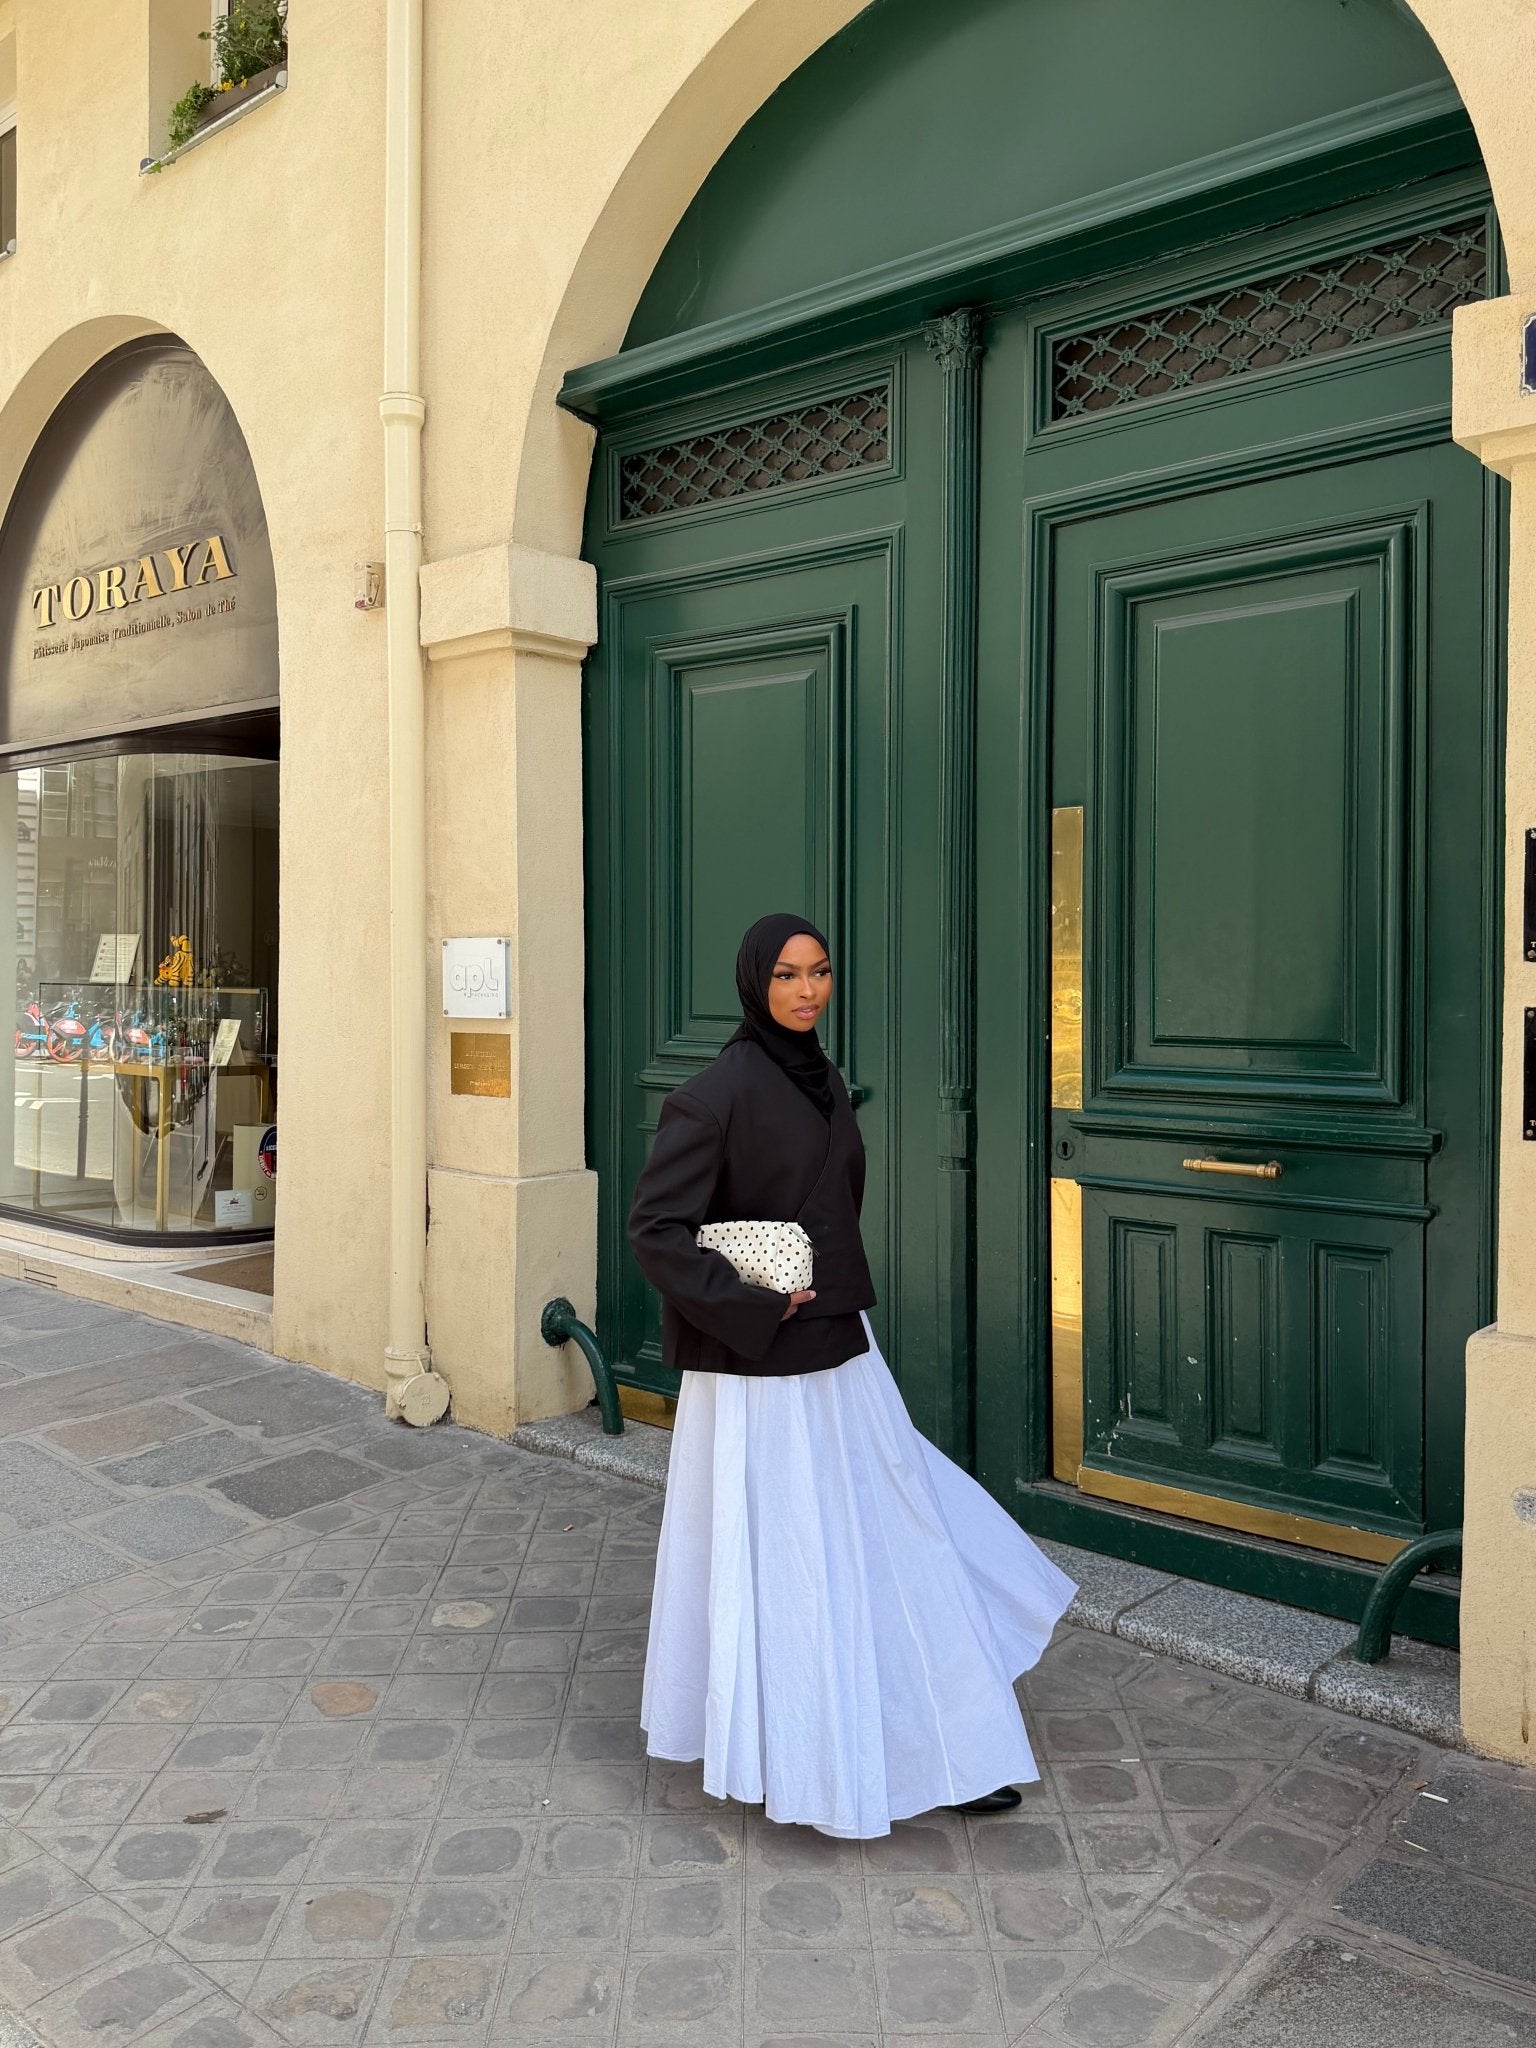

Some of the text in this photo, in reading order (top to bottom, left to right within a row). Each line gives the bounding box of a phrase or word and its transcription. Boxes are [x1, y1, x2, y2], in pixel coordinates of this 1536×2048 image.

[33, 535, 237, 629] TORAYA
[32, 638, 69, 660] Pâtisserie
[71, 632, 110, 651] Japonaise
[176, 608, 202, 624] Salon
[205, 603, 216, 617] de
[218, 596, 236, 614] Thé
